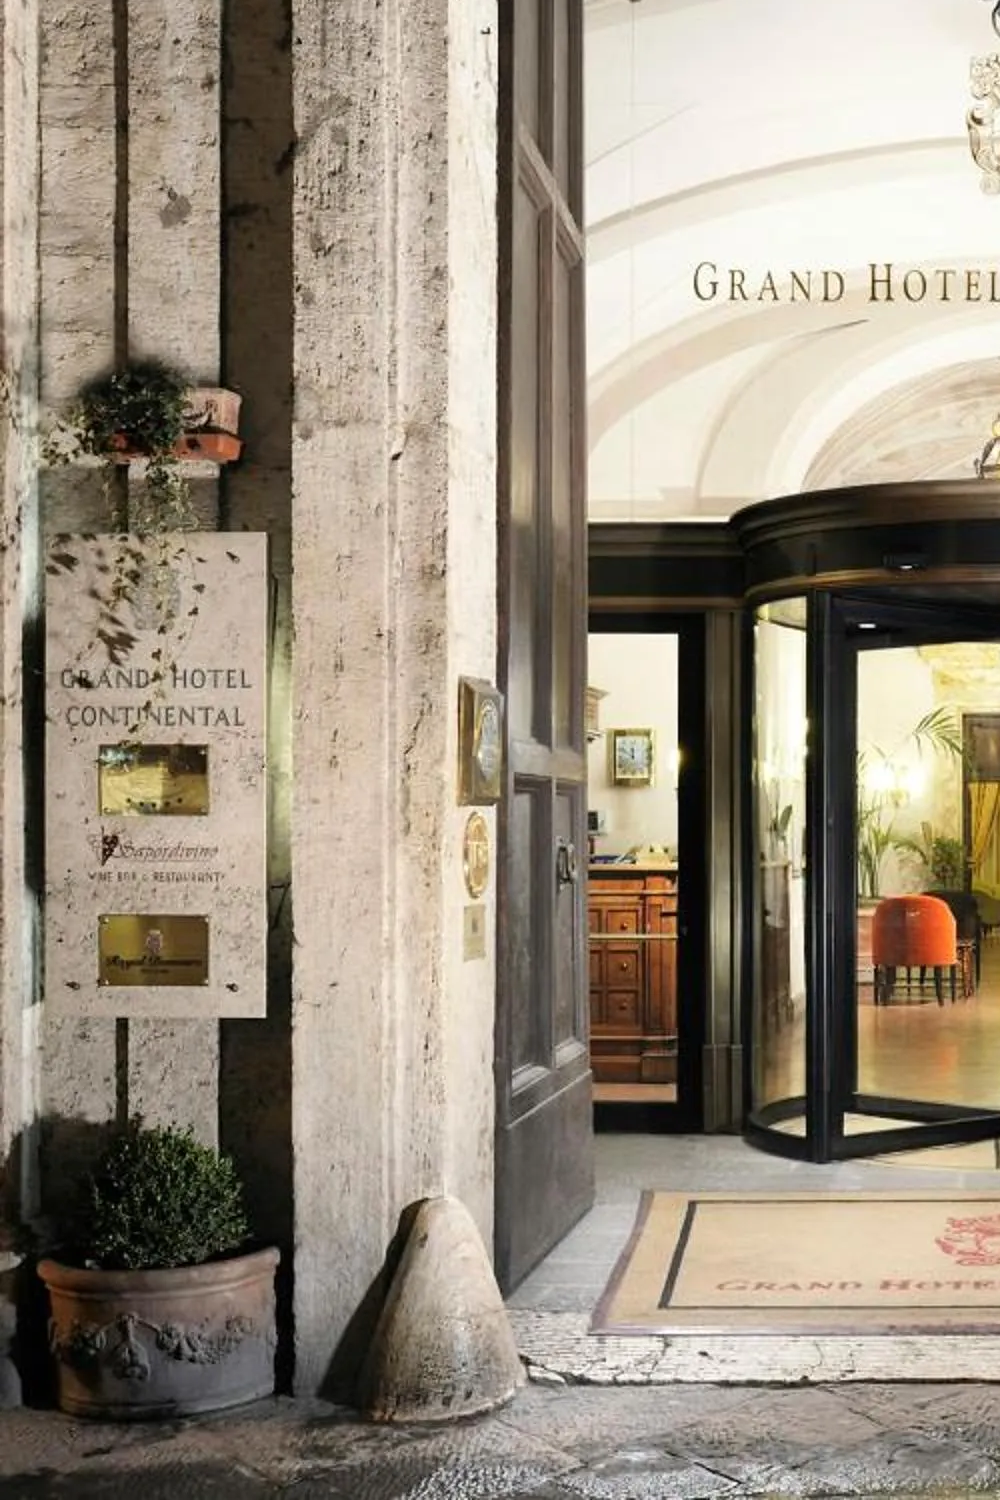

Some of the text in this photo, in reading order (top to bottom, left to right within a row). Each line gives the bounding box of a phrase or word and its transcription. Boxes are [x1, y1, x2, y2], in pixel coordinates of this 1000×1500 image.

[692, 261, 846, 303] GRAND
[60, 668, 252, 690] GRAND HOTEL
[65, 704, 246, 728] CONTINENTAL
